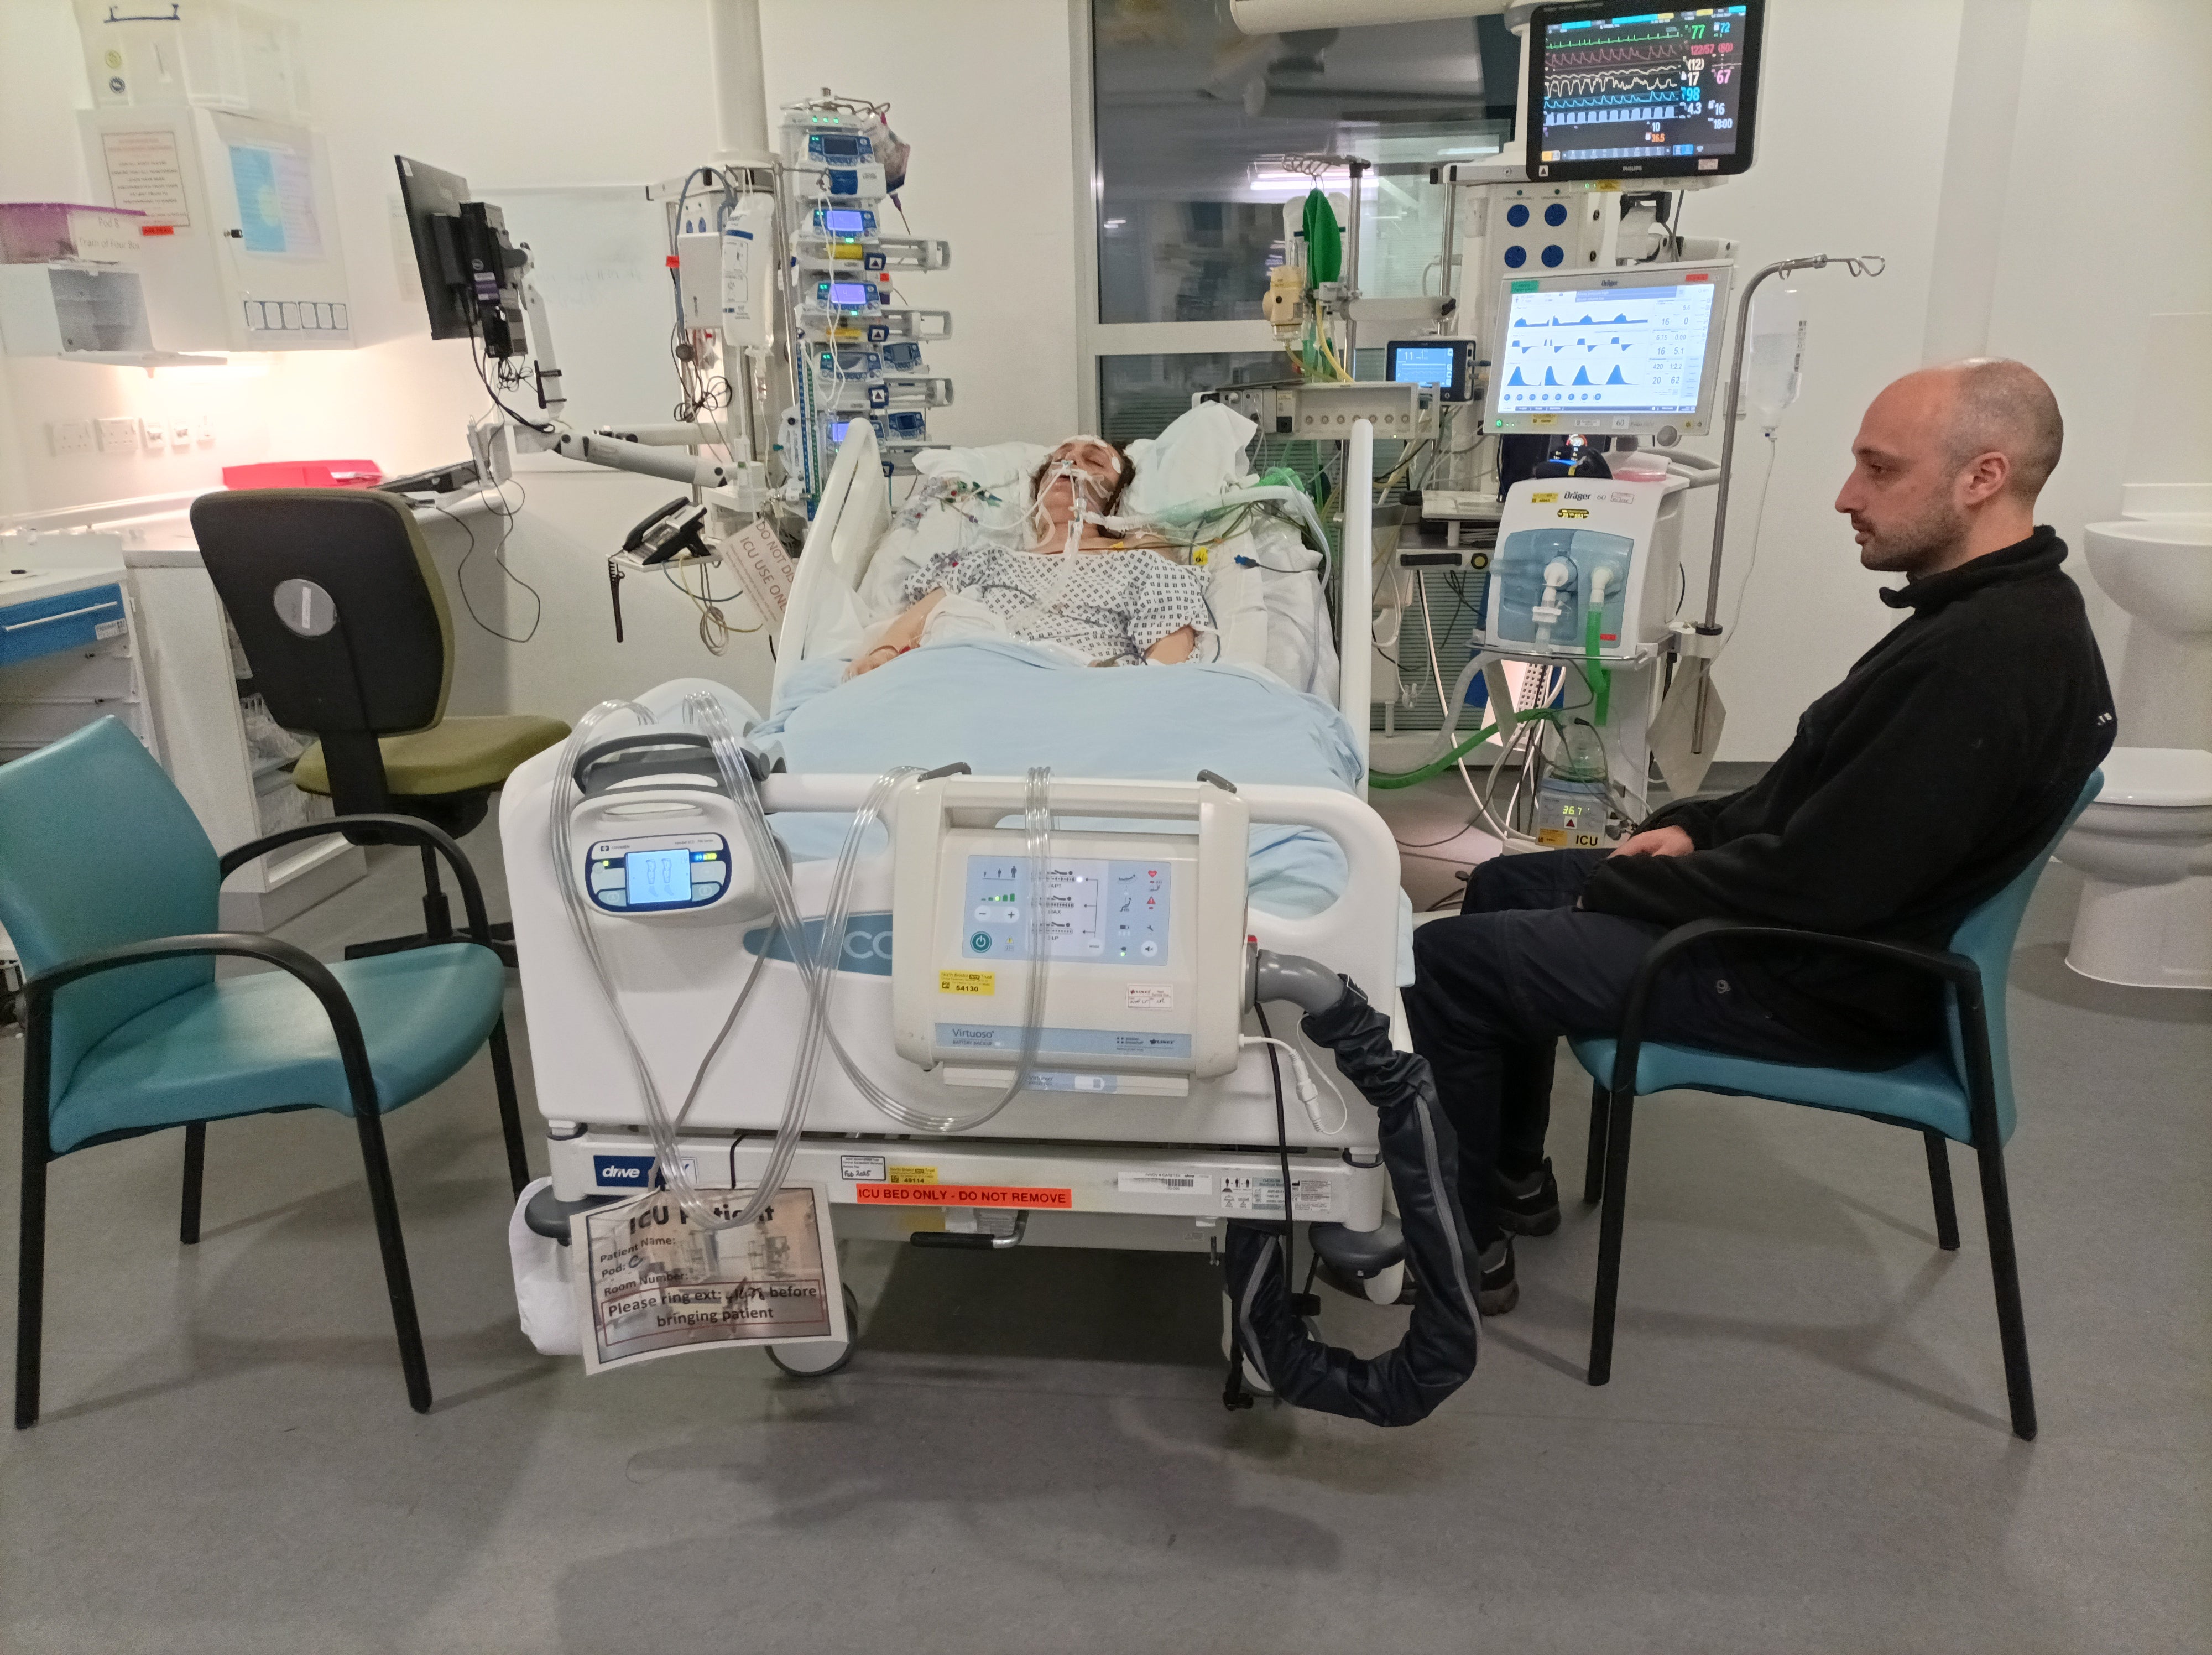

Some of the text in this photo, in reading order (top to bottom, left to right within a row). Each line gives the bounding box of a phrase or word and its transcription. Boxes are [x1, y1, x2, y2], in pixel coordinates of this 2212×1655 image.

[1691, 24, 1705, 40] 77
[1720, 22, 1730, 33] 72
[1688, 58, 1705, 71] (12)
[1688, 72, 1699, 86] 17
[1716, 69, 1731, 84] 67
[1687, 86, 1700, 101] 98
[1715, 102, 1725, 115] 16
[1652, 122, 1661, 132] 10
[1714, 118, 1733, 129] 18:00
[1564, 491, 1591, 501] Dräger
[756, 522, 770, 540] DO
[766, 541, 787, 563] NOT
[740, 537, 759, 559] ICU
[755, 560, 774, 584] USE
[1576, 835, 1598, 846] ICU
[602, 1165, 640, 1178] drive
[859, 1189, 879, 1198] ICU
[884, 1189, 909, 1199] BED
[913, 1190, 947, 1200] ONLY
[959, 1191, 978, 1201] DO
[982, 1191, 1008, 1201] NOT
[1012, 1192, 1066, 1203] REMOVE
[630, 1205, 669, 1235] ICU
[600, 1237, 676, 1263] Patient Name:
[602, 1264, 626, 1278] Pod:
[604, 1272, 688, 1297] Room Number:
[609, 1297, 657, 1317] Please
[661, 1292, 691, 1304] ring
[695, 1290, 722, 1300] ext:
[770, 1286, 817, 1298] before
[657, 1307, 774, 1327] bringing patient
